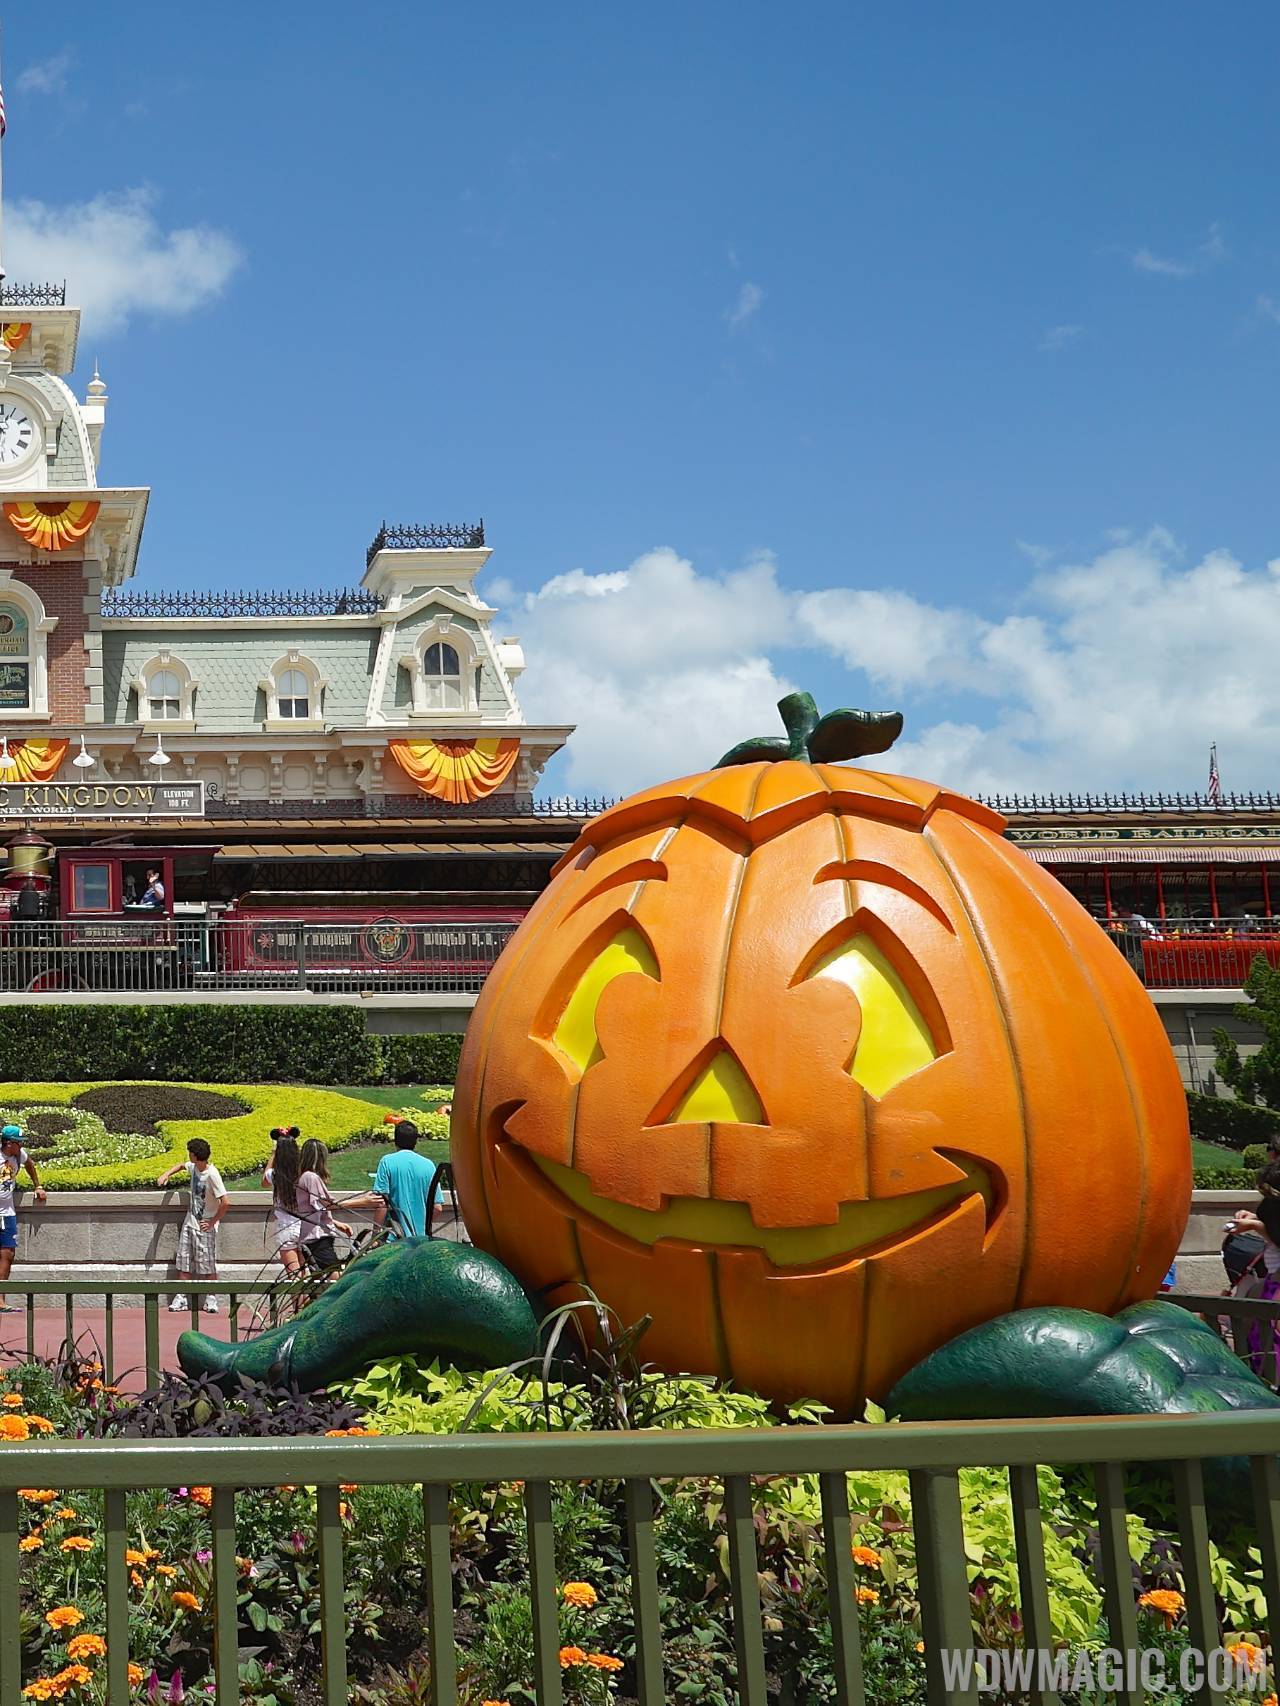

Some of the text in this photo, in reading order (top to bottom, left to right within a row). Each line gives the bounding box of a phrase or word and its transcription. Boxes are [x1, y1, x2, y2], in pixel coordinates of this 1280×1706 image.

[22, 786, 156, 807] KINGDOM
[30, 806, 77, 814] WORLD
[1011, 830, 1120, 841] WORLD
